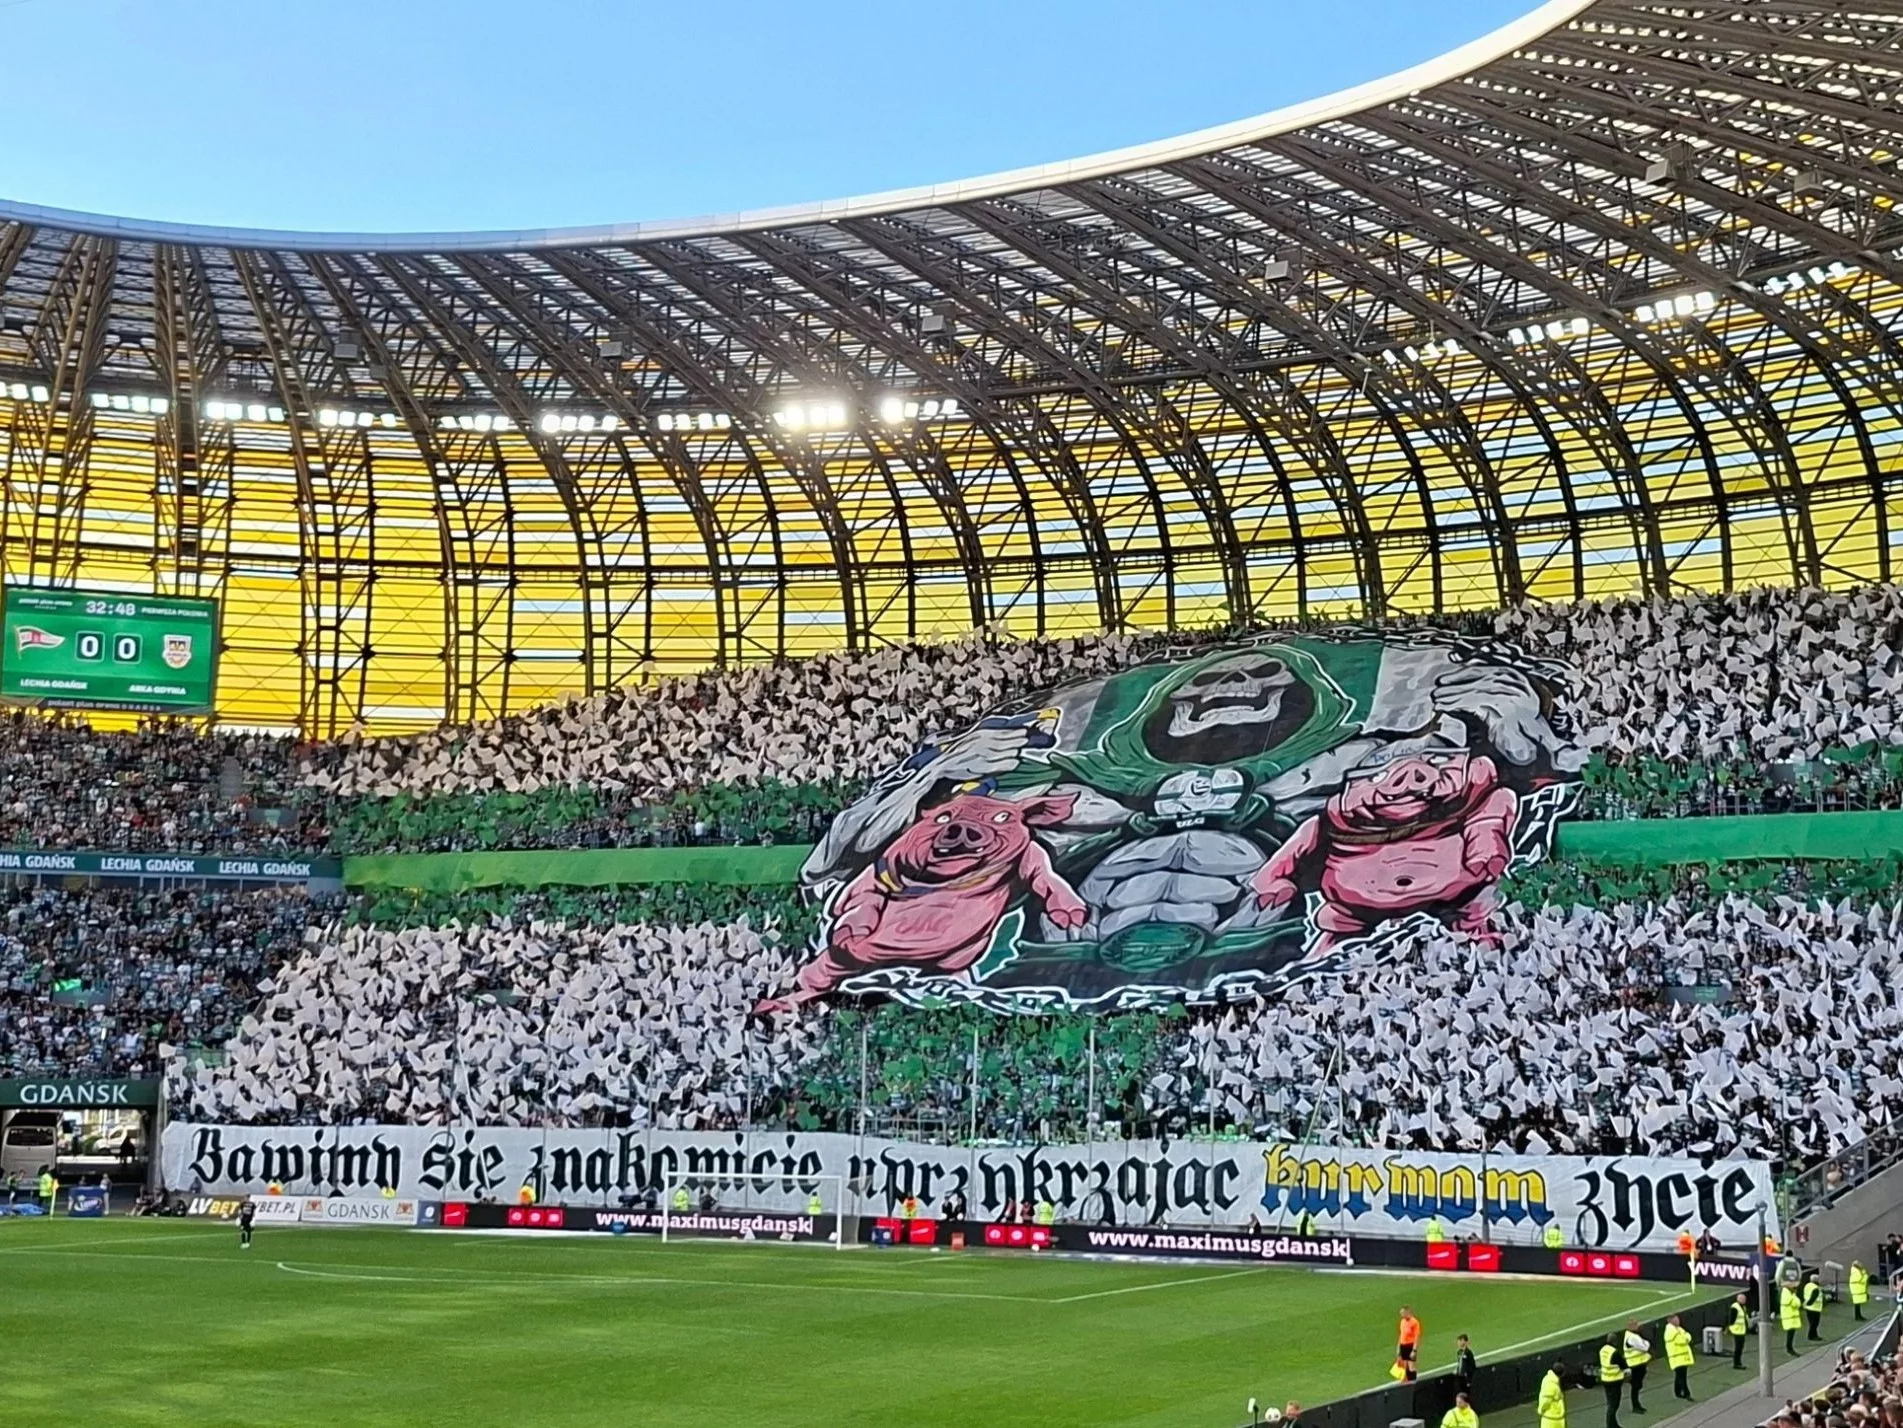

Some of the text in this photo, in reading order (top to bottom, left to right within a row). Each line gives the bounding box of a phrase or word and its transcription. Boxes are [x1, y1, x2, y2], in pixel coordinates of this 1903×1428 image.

[85, 600, 136, 616] 32:48
[80, 635, 136, 659] 0 0
[25, 853, 76, 869] GDAŃSK
[101, 857, 195, 872] LECHIA GDAŃSK
[219, 860, 311, 876] LECHIA GDAŃSK
[20, 1081, 128, 1104] GDAŃSK
[188, 1127, 401, 1190] Bawimy
[522, 1129, 823, 1203] znakomicie
[327, 1200, 390, 1219] GDAŃSK
